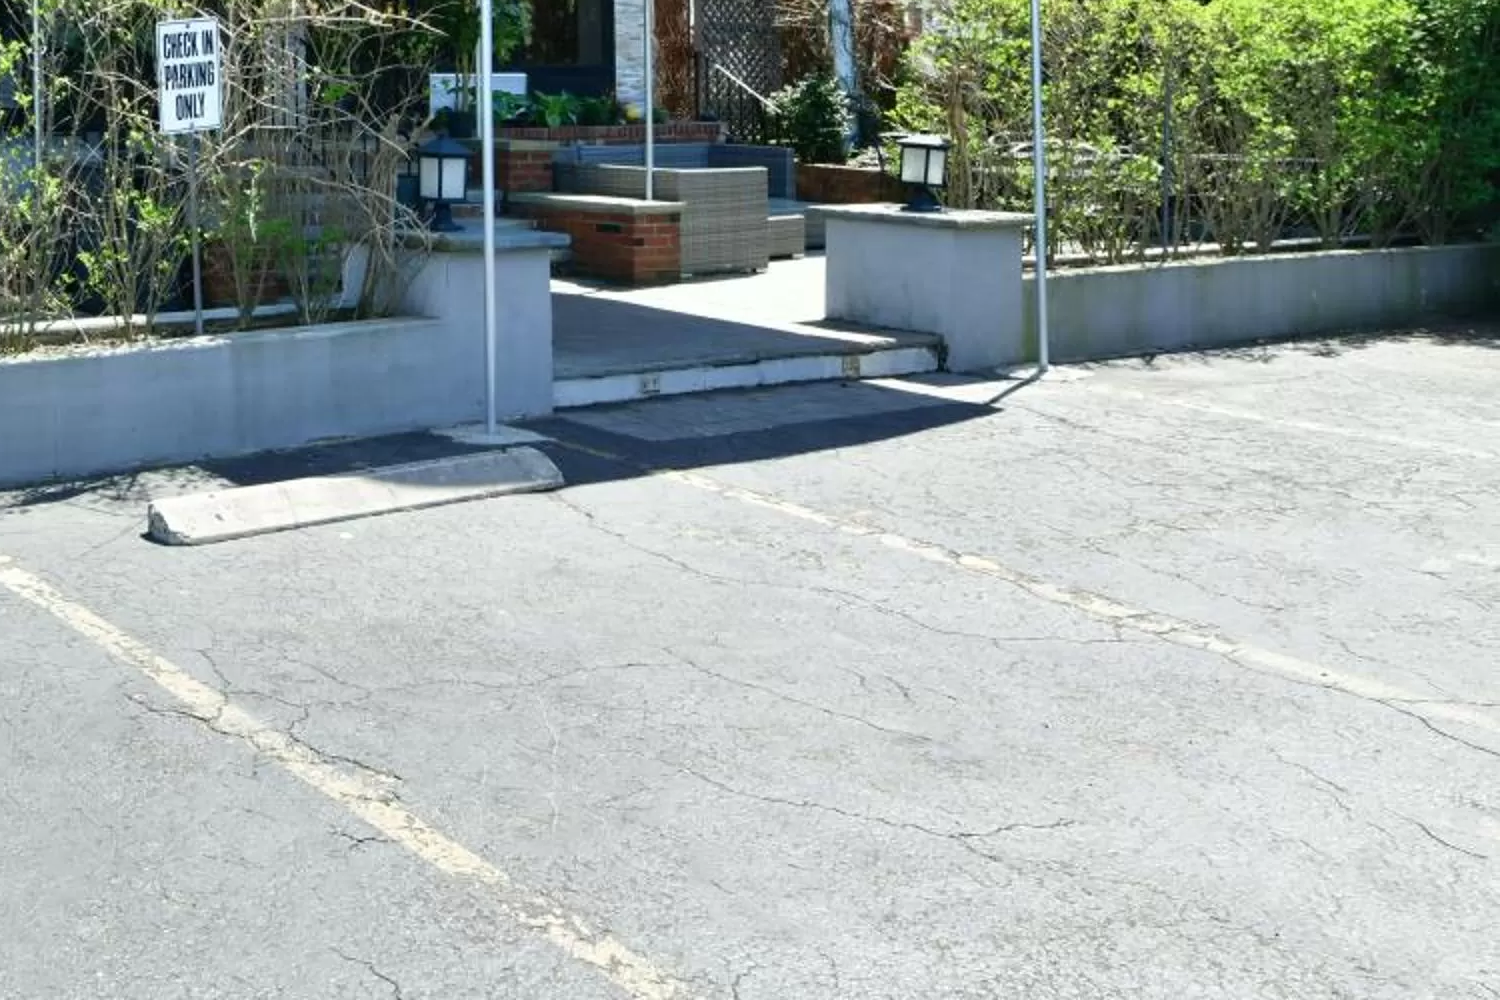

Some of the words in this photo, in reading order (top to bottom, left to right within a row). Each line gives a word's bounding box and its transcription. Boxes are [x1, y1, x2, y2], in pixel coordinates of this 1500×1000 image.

[163, 31, 198, 59] CHECK
[201, 29, 214, 55] IN
[164, 61, 215, 90] PARKING
[175, 92, 205, 120] ONLY
